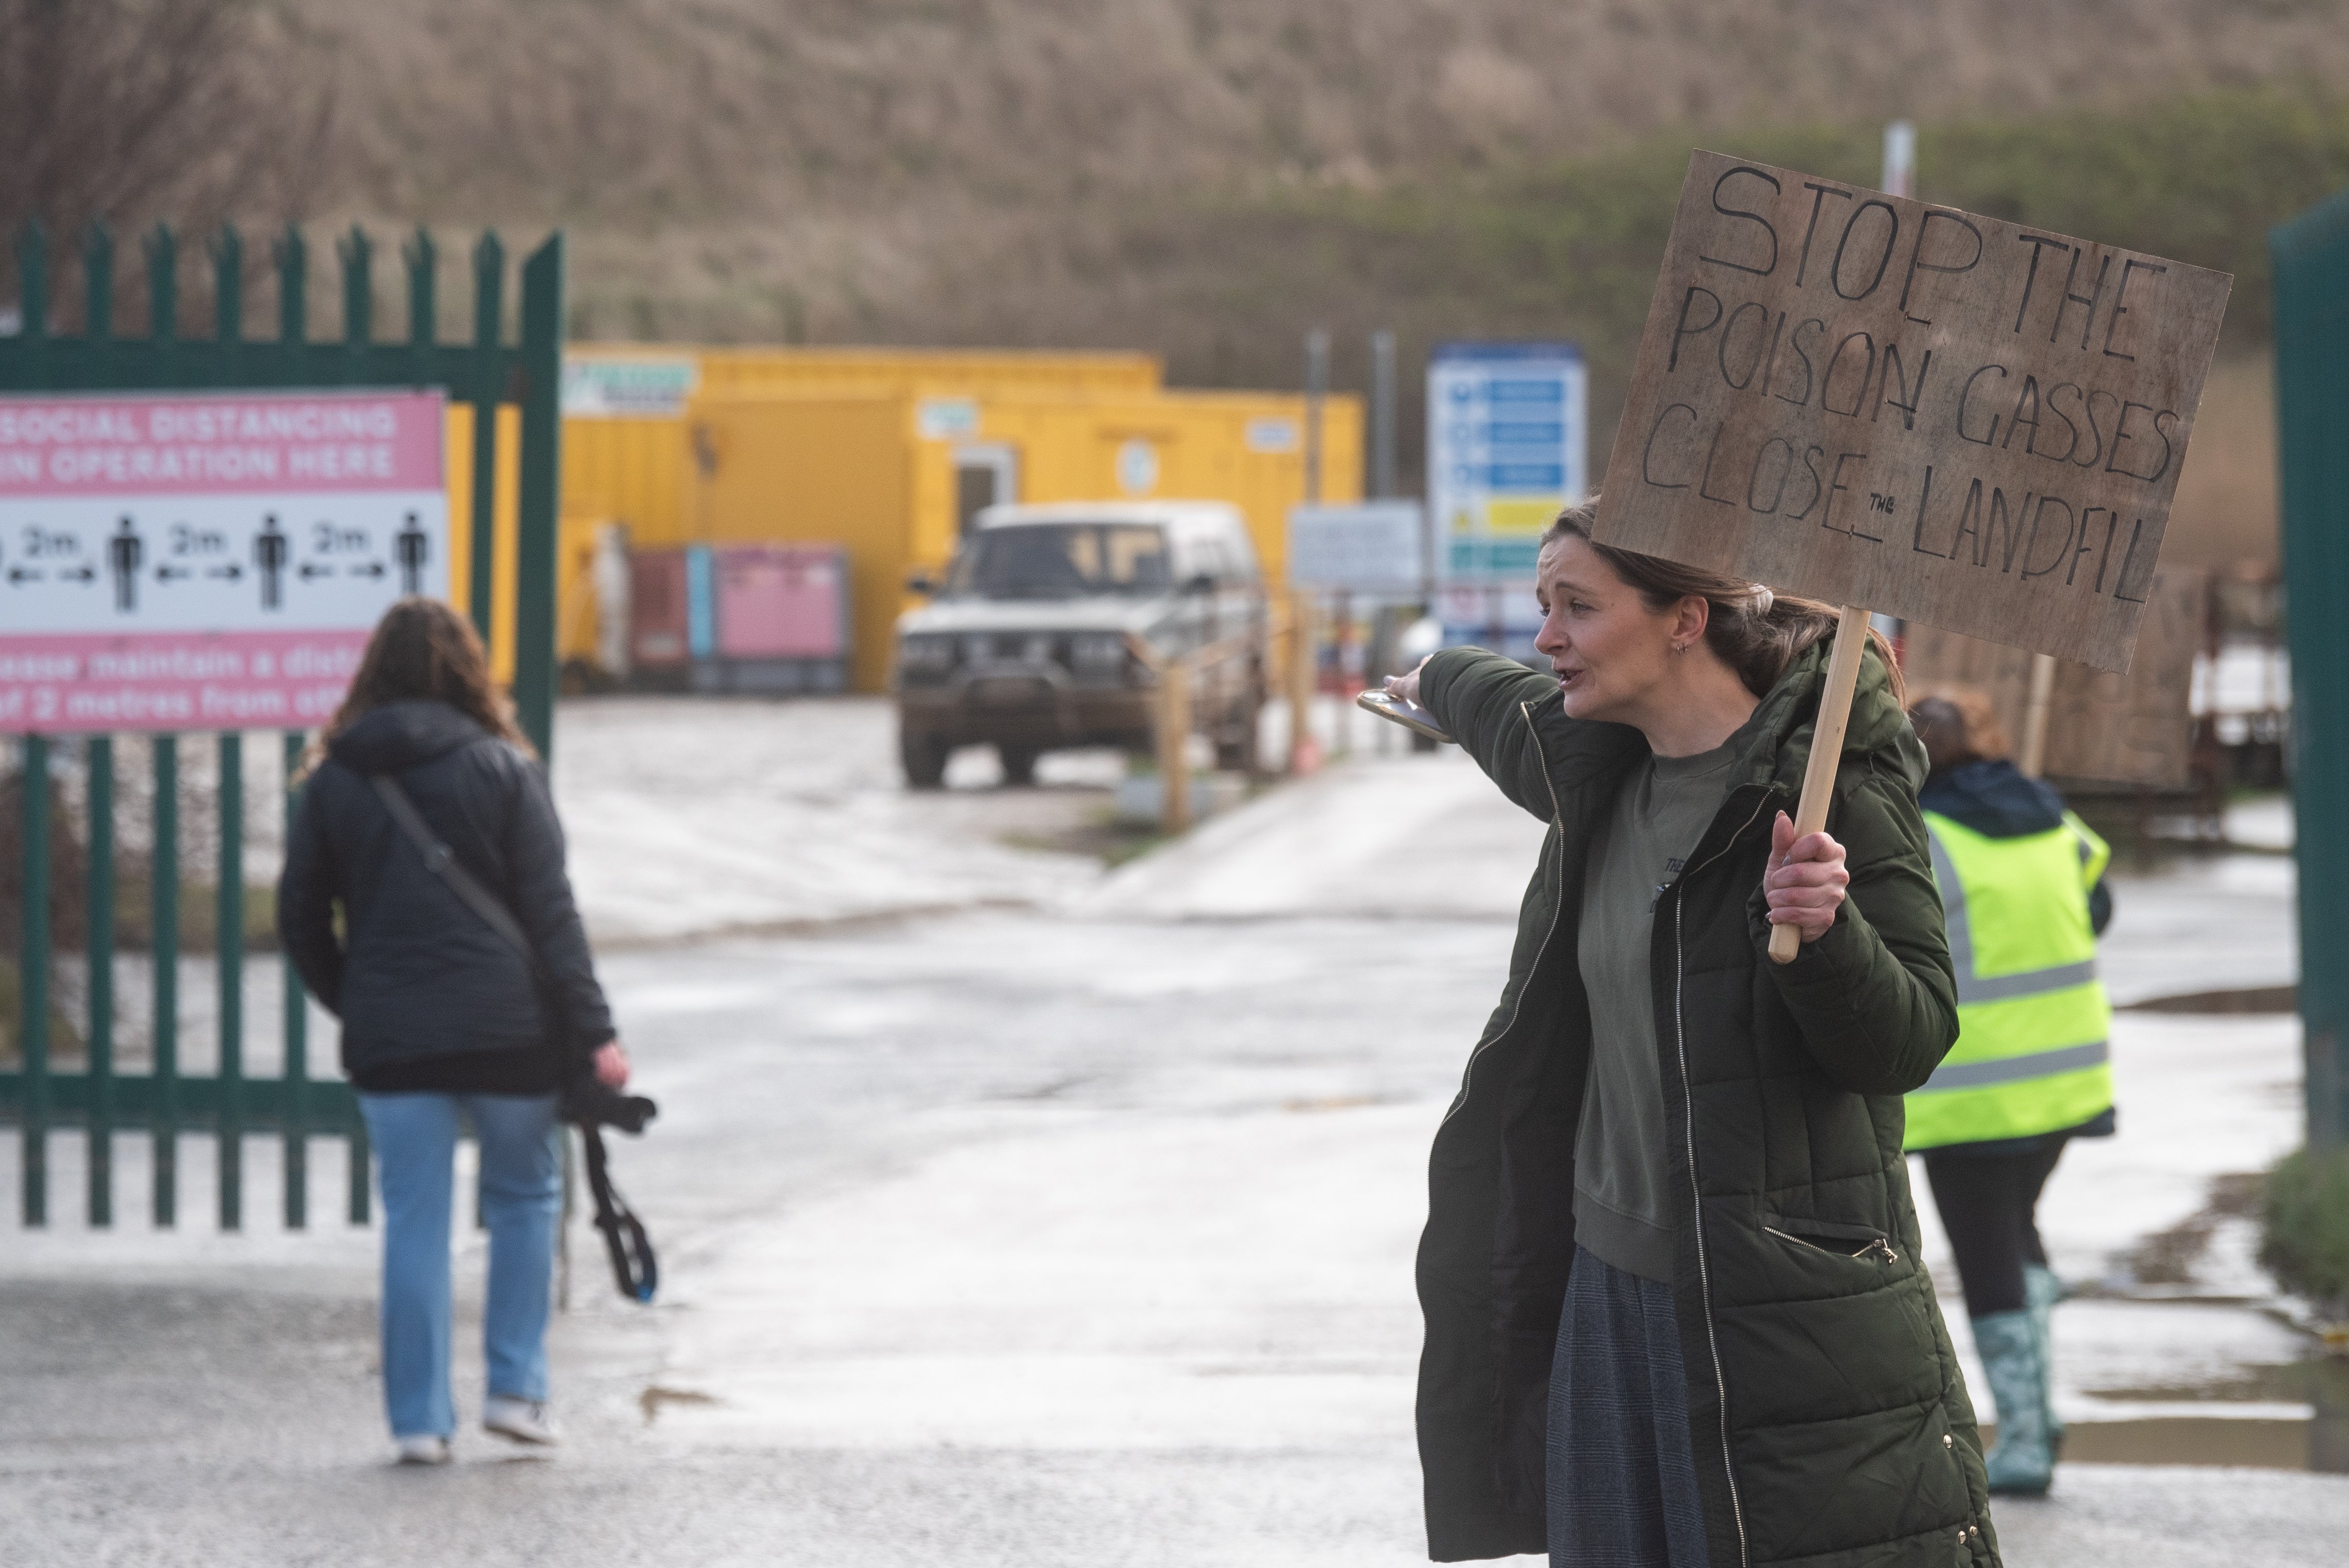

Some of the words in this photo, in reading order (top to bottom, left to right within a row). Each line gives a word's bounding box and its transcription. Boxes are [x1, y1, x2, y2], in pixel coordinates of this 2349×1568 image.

[1699, 167, 1982, 312] STOP
[2015, 234, 2166, 362] THE
[1668, 286, 1932, 430] POISON
[1956, 364, 2180, 482] GASSES
[0, 409, 139, 443] SOCIAL
[151, 405, 395, 441] DISTANCING
[50, 445, 278, 483] OPERATION
[289, 443, 392, 479] HERE
[1642, 404, 1883, 542] CLOSE
[1870, 492, 1895, 515] THE
[1913, 465, 2145, 604] LANDFIL
[23, 523, 79, 557] 2m
[170, 522, 228, 556] 2m
[312, 519, 369, 554] 2m
[88, 647, 243, 680] maintain
[253, 651, 274, 678] a
[33, 686, 59, 720] 2
[67, 689, 190, 720] metres
[201, 686, 284, 719] from
